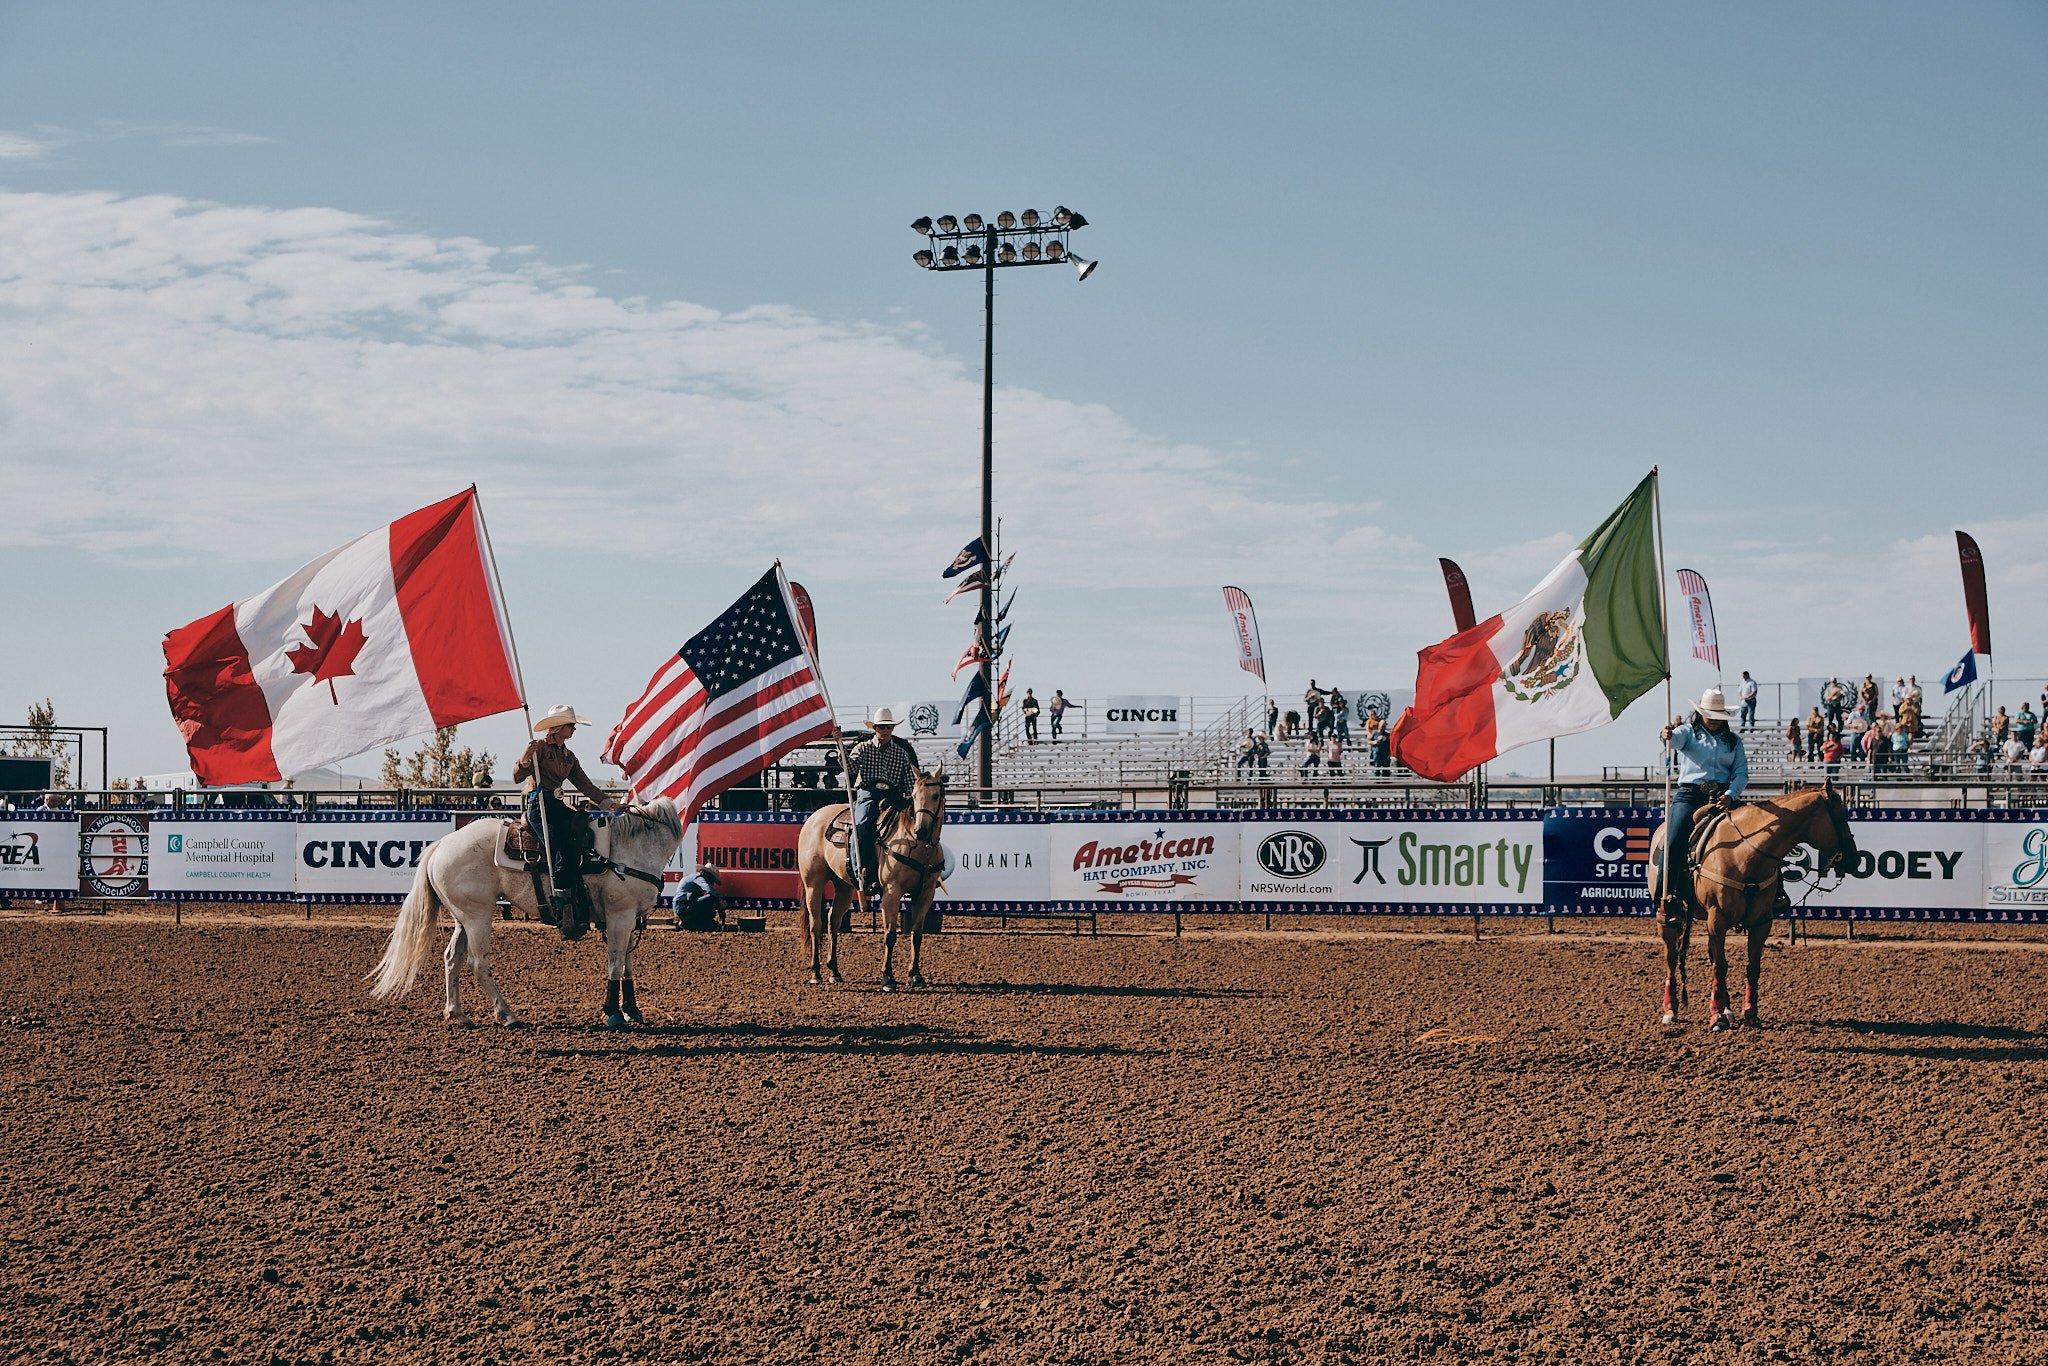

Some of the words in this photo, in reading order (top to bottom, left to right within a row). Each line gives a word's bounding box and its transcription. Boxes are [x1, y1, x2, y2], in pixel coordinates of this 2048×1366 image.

[1237, 611, 1252, 657] American
[1106, 708, 1177, 722] CINCH
[97, 815, 115, 828] HIGH
[116, 815, 143, 834] SCHOO
[186, 838, 230, 852] Campbell
[231, 839, 265, 853] County
[1073, 835, 1215, 872] American
[1267, 835, 1314, 873] NRS
[187, 852, 230, 863] Memorial
[234, 852, 274, 865] Hospital
[703, 846, 799, 869] HUTCHISO
[962, 853, 1033, 870] QUANTA
[1397, 831, 1533, 894] Smarty
[1083, 870, 1108, 882] HAT
[1110, 862, 1178, 879] COMPANY,
[1181, 859, 1211, 871] INC.
[90, 879, 141, 897] ASSOCIATION
[1251, 883, 1332, 893] NRSWorld.com
[1580, 887, 1650, 899] AGRICULTURE
